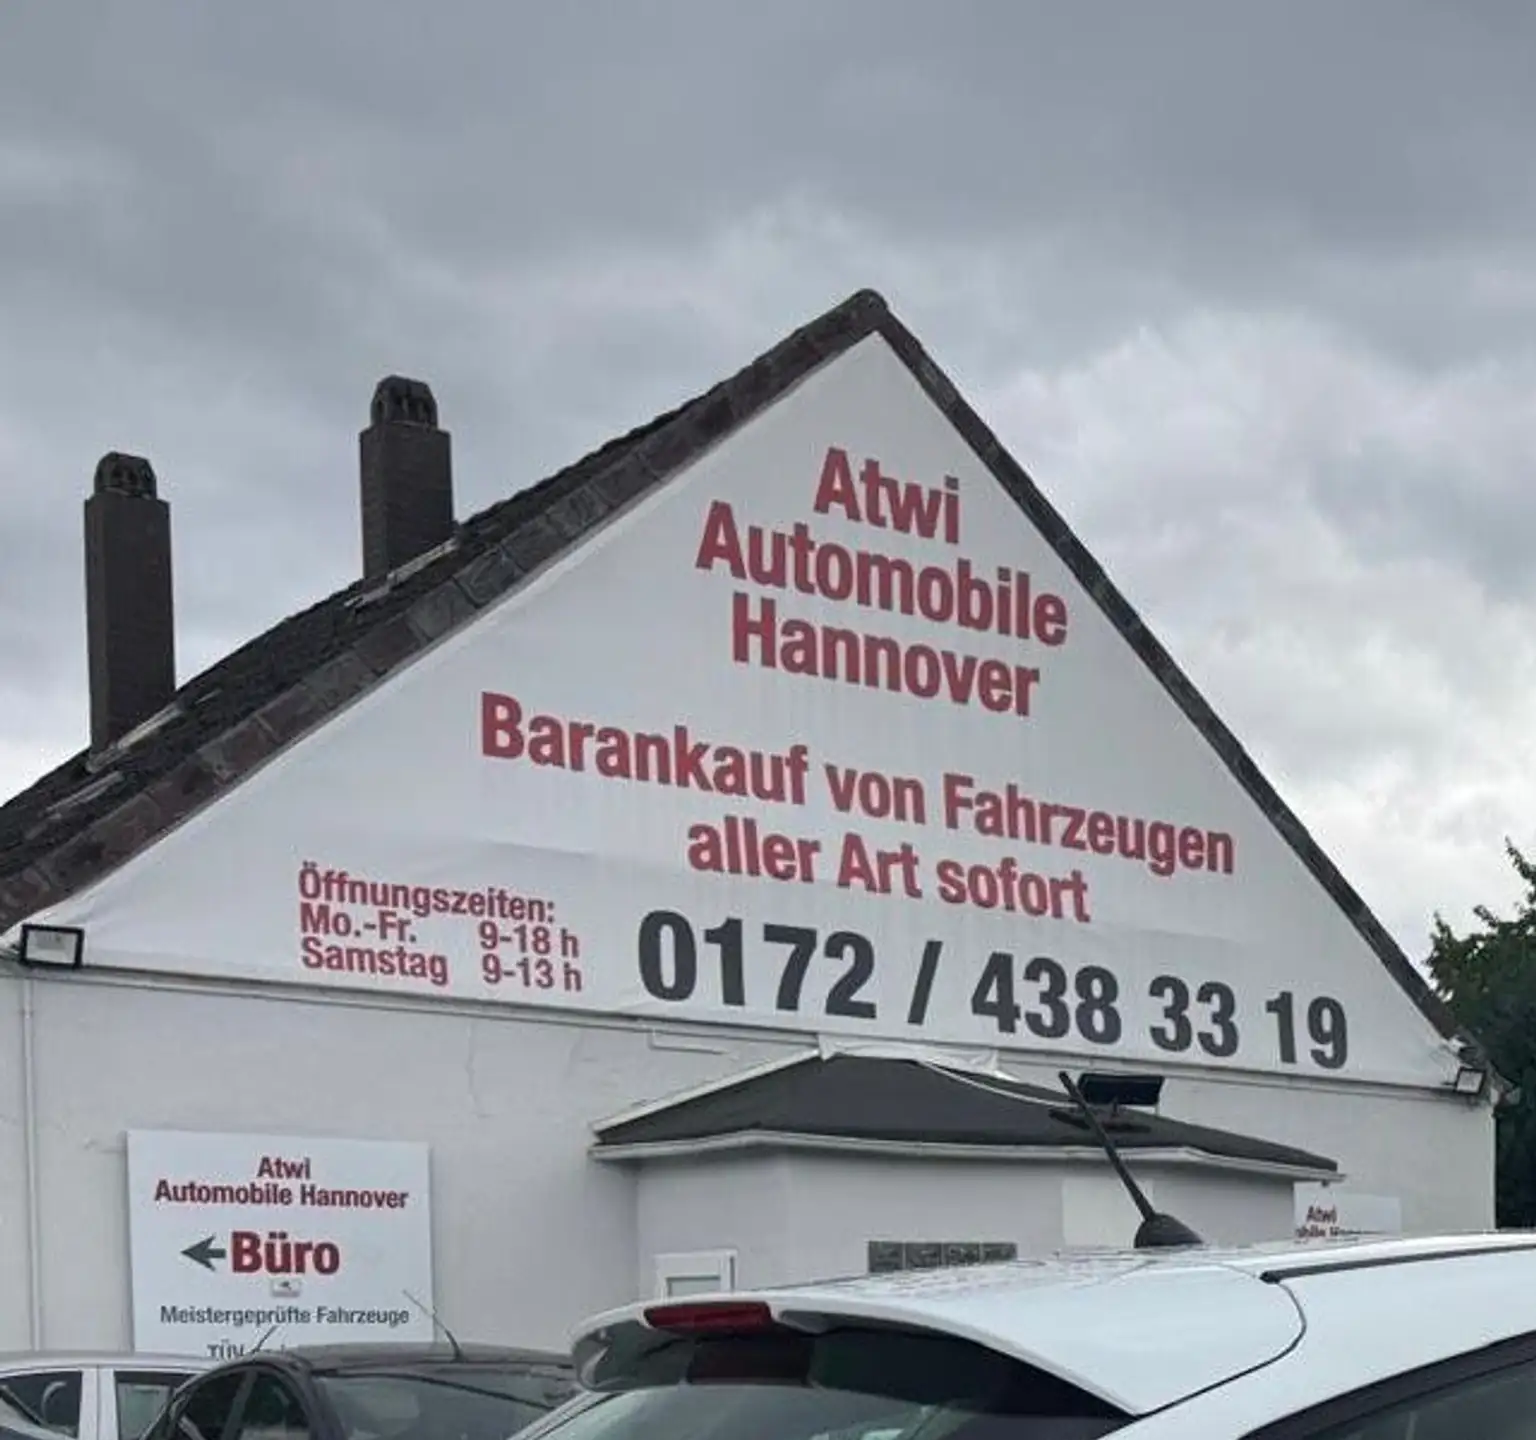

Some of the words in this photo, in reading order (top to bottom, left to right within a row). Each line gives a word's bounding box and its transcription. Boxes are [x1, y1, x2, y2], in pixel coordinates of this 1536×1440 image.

[813, 448, 960, 546] Atwi
[695, 499, 1068, 647] Automobile
[732, 590, 1041, 718] Hannover
[481, 691, 810, 806] Barankauf
[823, 763, 926, 826] von
[943, 772, 1234, 876] Fahrzeugen
[298, 861, 555, 922] Öffnungszeiten:
[687, 816, 822, 884] aller
[836, 832, 923, 900] Art
[936, 856, 1091, 924] sofort
[300, 905, 417, 944] Mo.-Fr.
[478, 920, 553, 956] 9-18
[560, 927, 580, 959] h
[301, 936, 449, 987] Samstag
[481, 957, 555, 990] 9-13
[563, 963, 582, 992] h
[638, 910, 877, 1019] 0172
[907, 939, 944, 1026] /
[970, 951, 1122, 1045] 438
[1148, 974, 1239, 1058] 33
[1265, 990, 1348, 1070] 19
[154, 1179, 293, 1206] Automobile
[300, 1183, 409, 1209] Hannover
[256, 1156, 311, 1180] Atwi
[231, 1230, 340, 1276] Büro
[160, 1305, 310, 1326] Meistergeprüfte
[316, 1305, 410, 1326] Fahrzeuge
